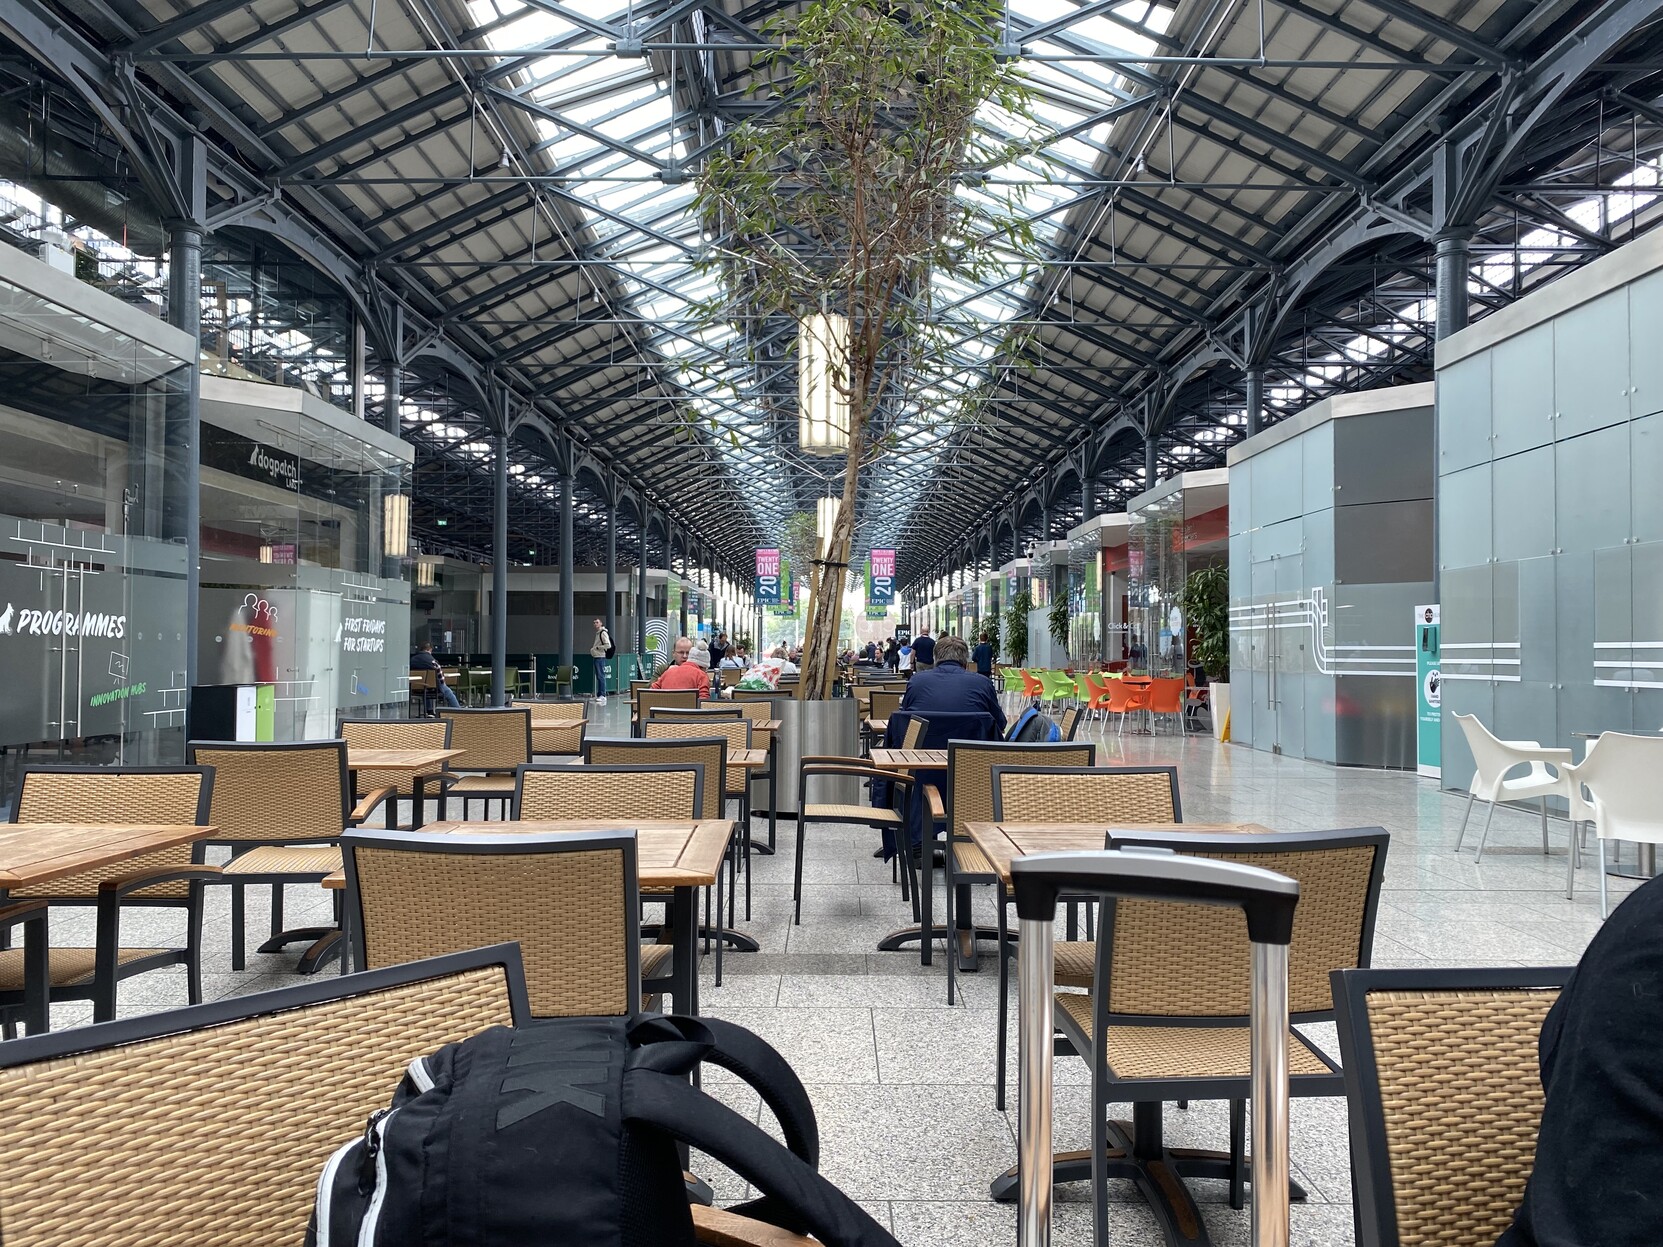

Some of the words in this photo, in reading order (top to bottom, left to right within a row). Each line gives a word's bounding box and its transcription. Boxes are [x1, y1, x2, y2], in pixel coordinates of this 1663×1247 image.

[258, 448, 297, 479] dogpatch
[757, 562, 779, 575] ONE
[872, 563, 894, 576] ONE
[759, 575, 777, 595] 20
[874, 576, 892, 596] 20
[16, 609, 126, 638] PROGRAMMES
[344, 617, 363, 633] FIRST
[362, 618, 386, 634] FRIDAYS
[343, 637, 356, 653] FOR
[356, 637, 385, 653] STARTUPS
[90, 687, 129, 706] INNOVATION
[130, 682, 147, 696] HUBS
